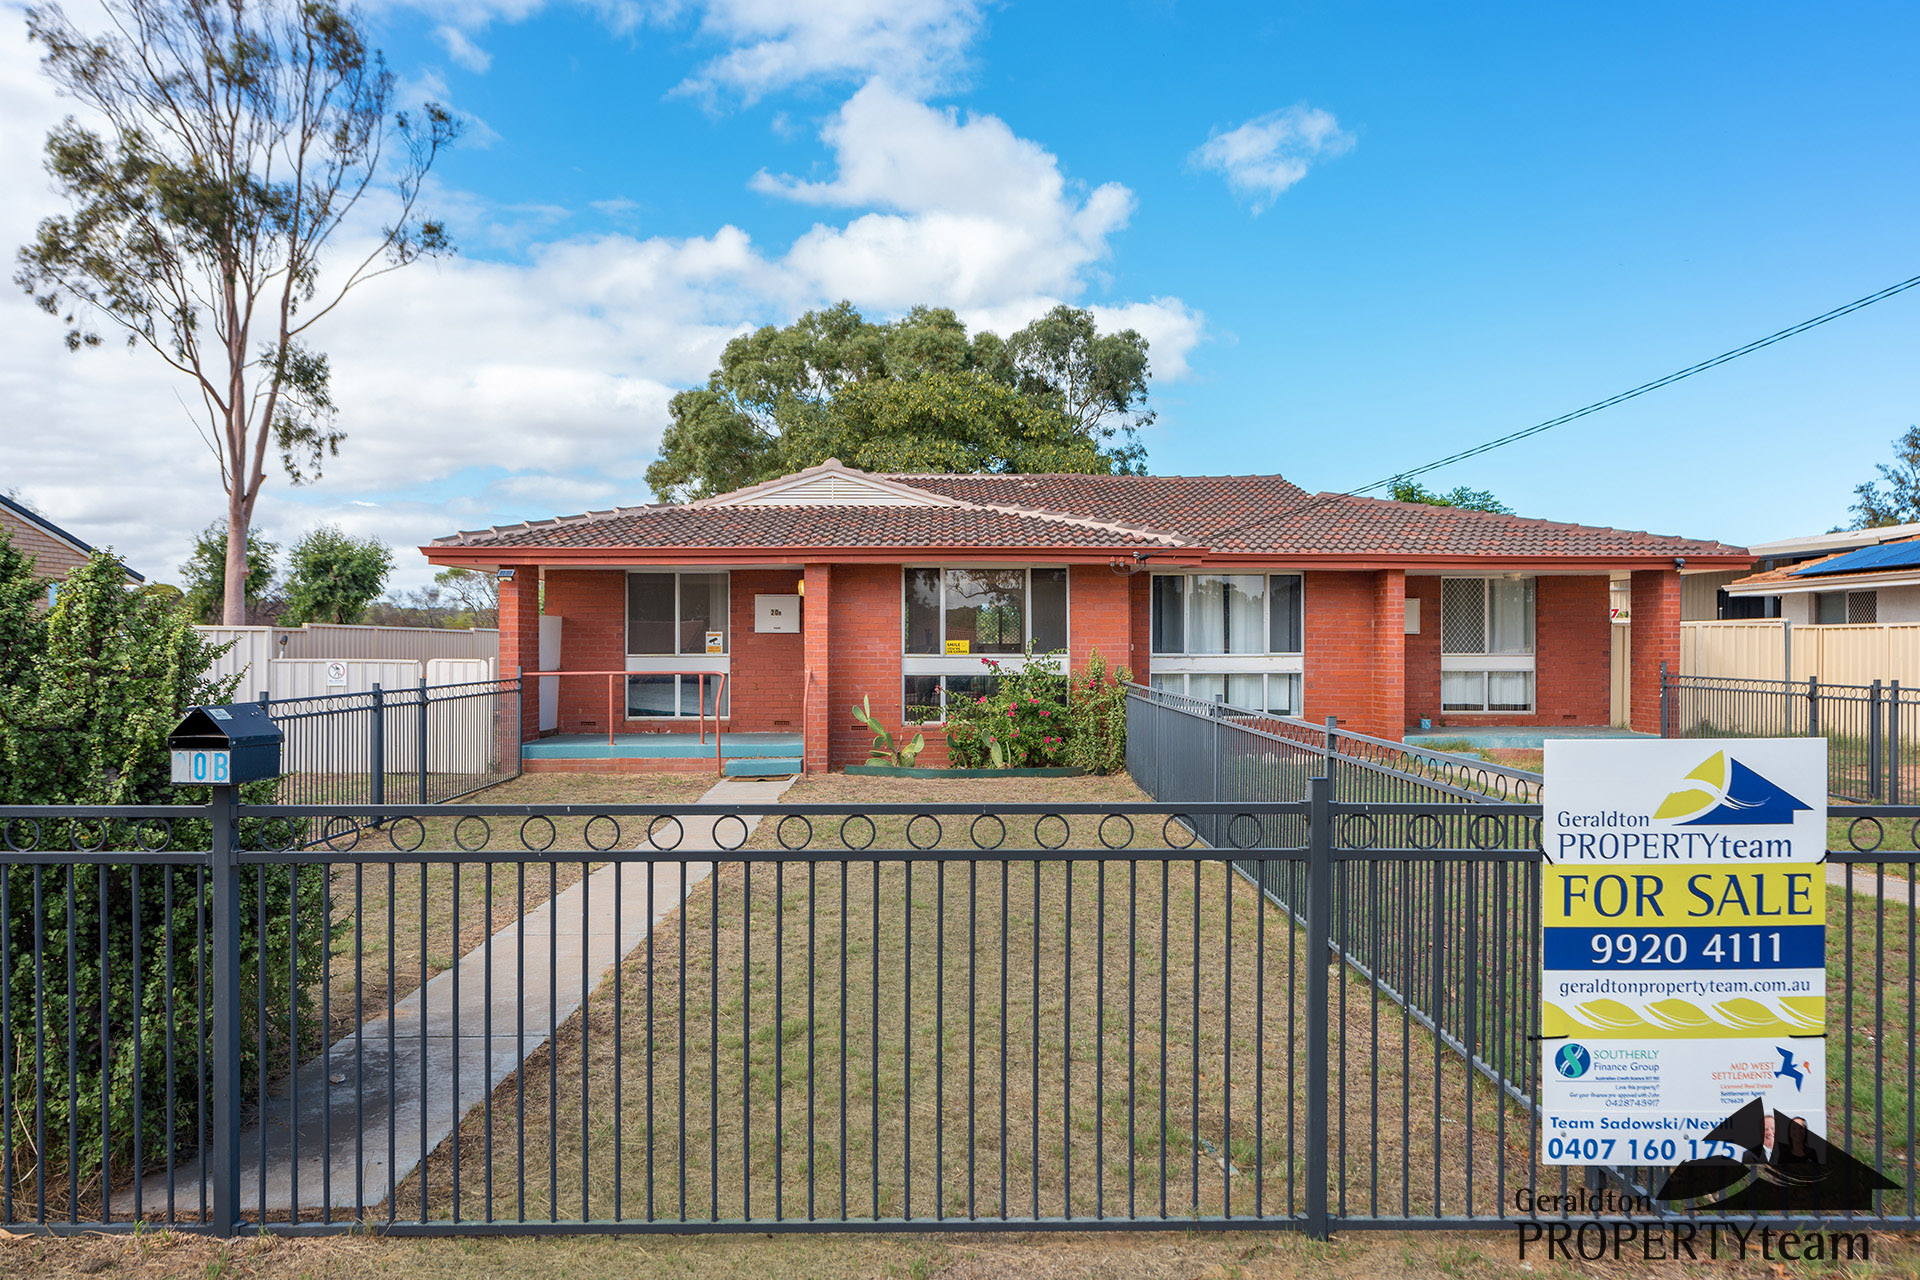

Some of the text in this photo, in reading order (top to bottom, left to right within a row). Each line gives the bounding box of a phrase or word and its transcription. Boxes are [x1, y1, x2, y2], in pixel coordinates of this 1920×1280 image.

[1557, 810, 1650, 827] Geraldton
[1557, 832, 1793, 860] PROPERTYteam
[1558, 873, 1813, 918] FOR SALE
[1591, 931, 1782, 965] 9920 4111
[1559, 978, 1811, 997] geraldtonpropertyteam.com.au
[1593, 1049, 1659, 1060] SOUTHERLY
[1593, 1061, 1660, 1073] Finance Group
[1731, 1061, 1775, 1071] MID WEST
[1712, 1071, 1773, 1080] SETTLEMENTS
[1550, 1116, 1594, 1129] Team
[1548, 1138, 1736, 1160] 0407 160 175
